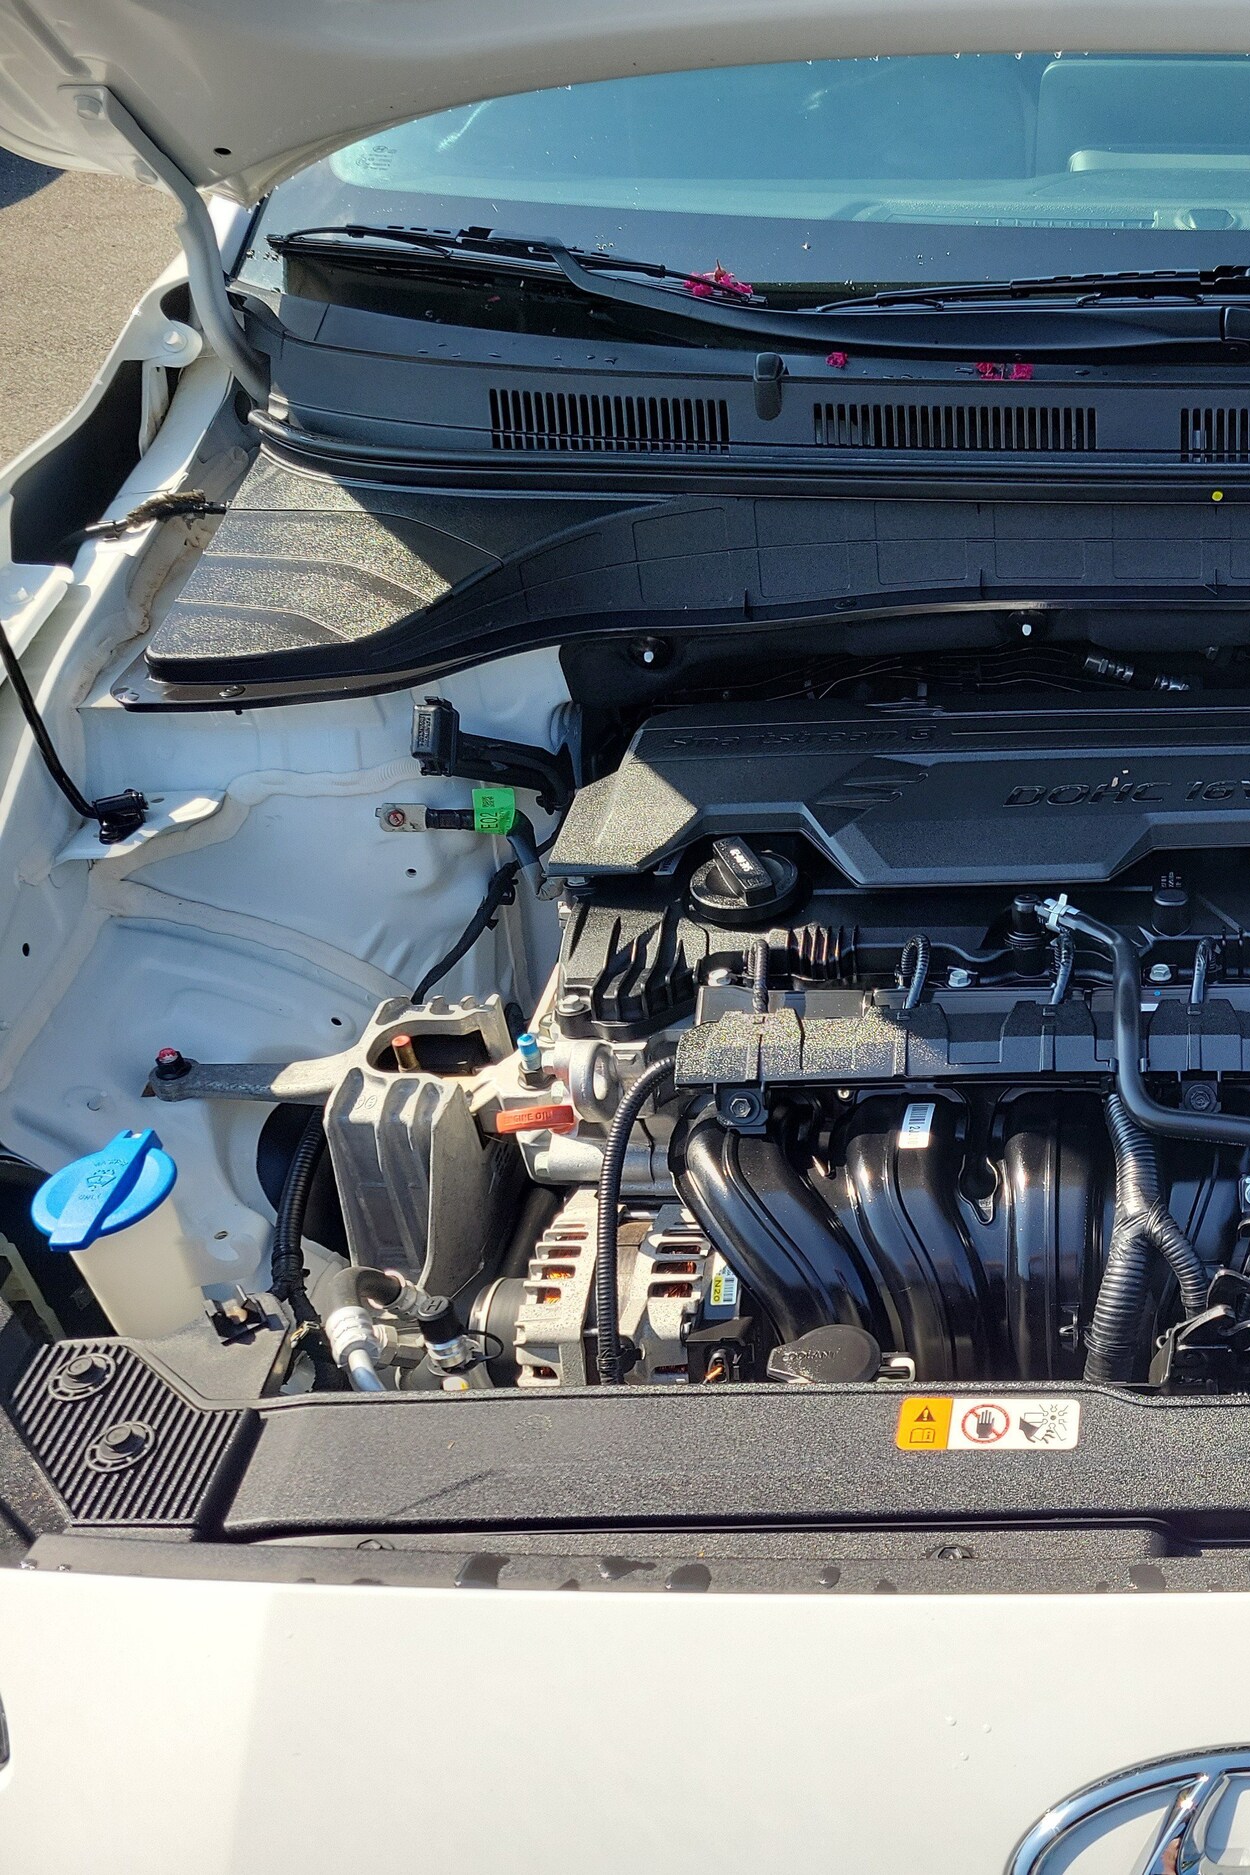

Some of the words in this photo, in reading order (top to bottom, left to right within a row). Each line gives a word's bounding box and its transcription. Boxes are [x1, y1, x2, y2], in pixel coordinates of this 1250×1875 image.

[1002, 781, 1172, 808] DOHC
[713, 1280, 722, 1302] N20
[426, 1300, 444, 1311] H
